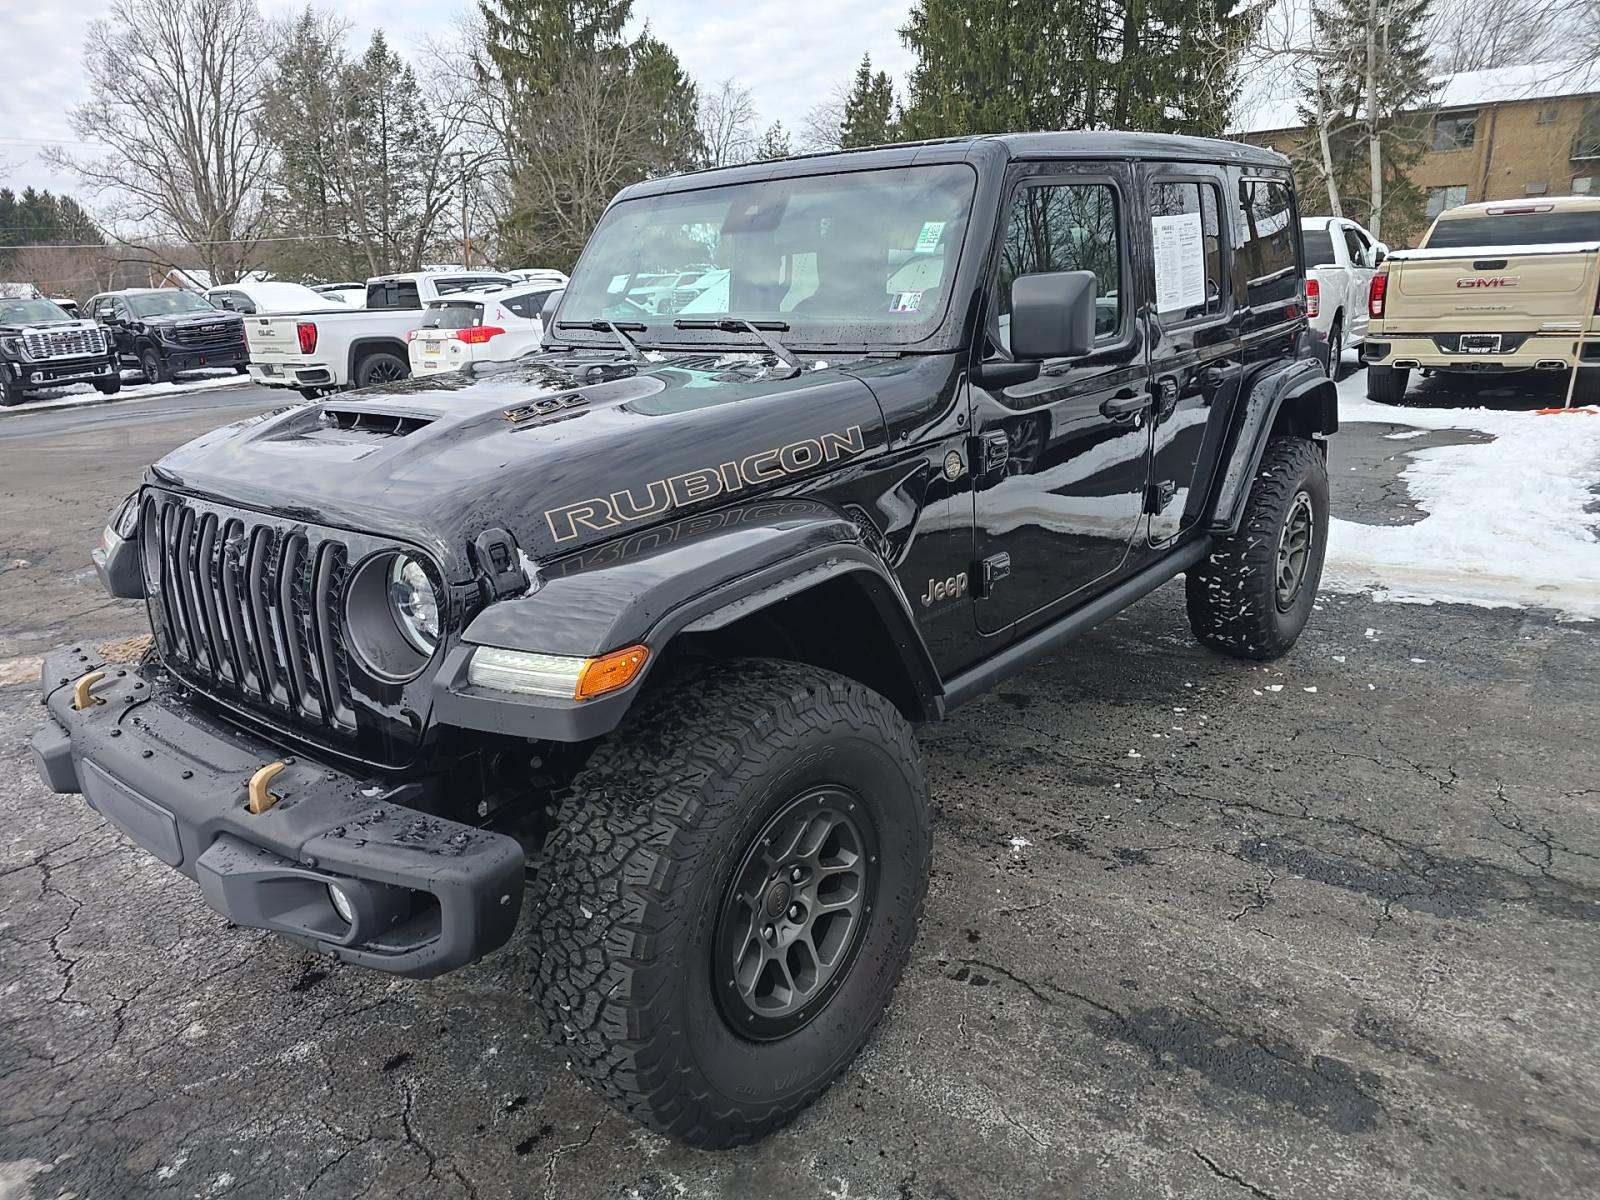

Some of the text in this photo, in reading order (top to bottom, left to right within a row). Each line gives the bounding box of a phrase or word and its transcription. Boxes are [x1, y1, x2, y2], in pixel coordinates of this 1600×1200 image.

[1456, 275, 1520, 289] GMC
[543, 425, 866, 543] RUBICON
[920, 571, 969, 607] Jeep
